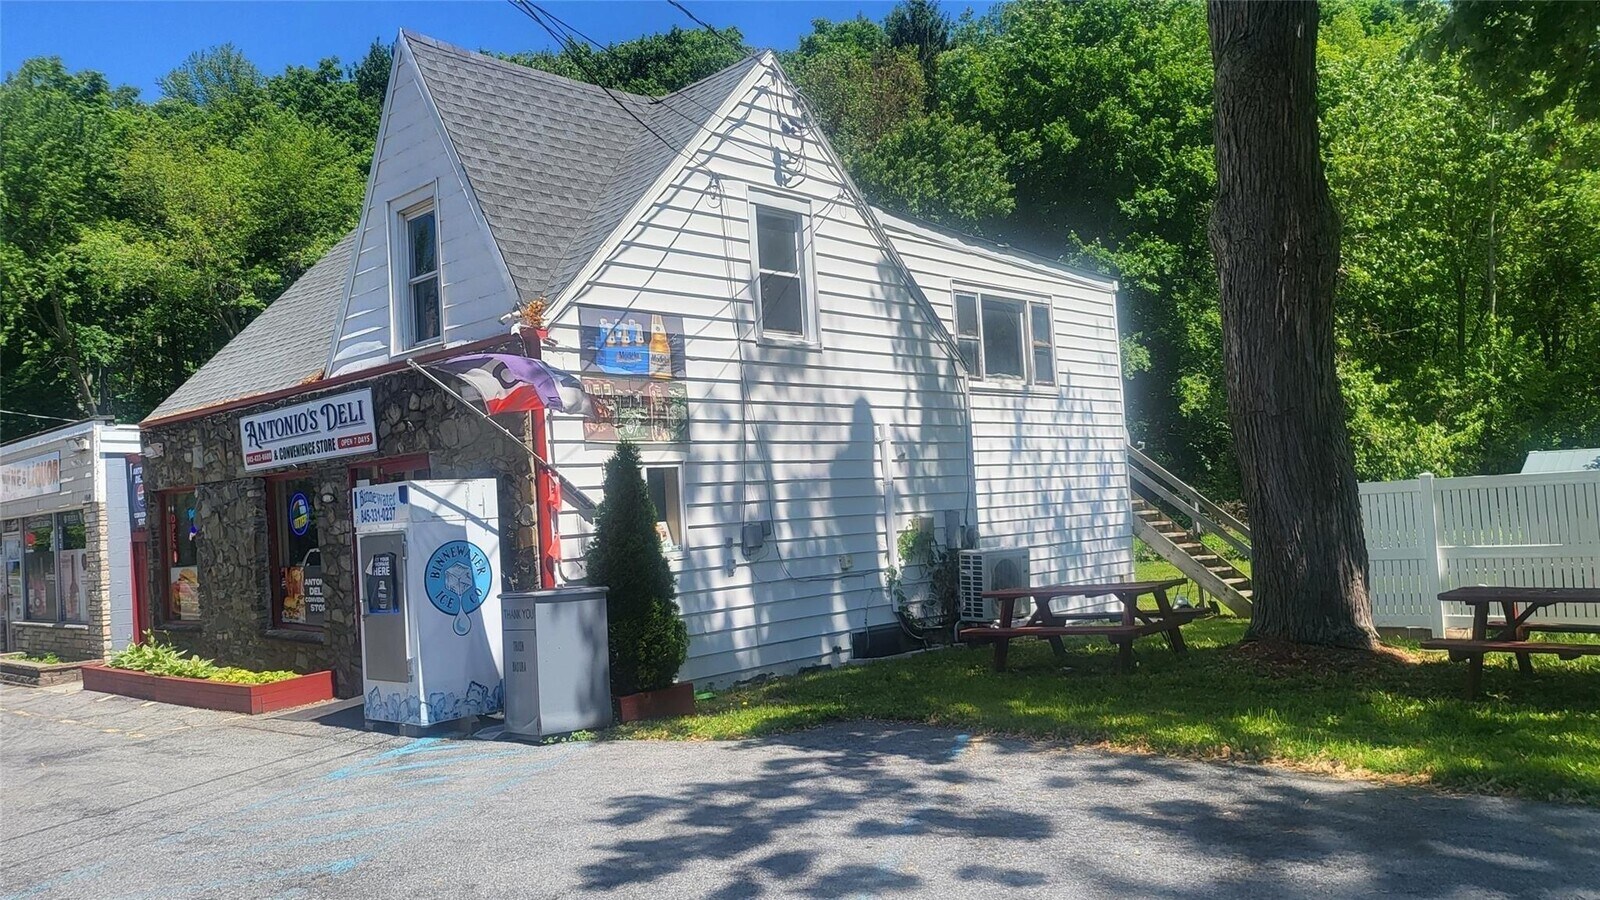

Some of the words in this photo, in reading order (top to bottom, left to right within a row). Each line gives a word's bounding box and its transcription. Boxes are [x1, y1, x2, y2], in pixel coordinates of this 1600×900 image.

[244, 409, 319, 449] ANTONIO'S
[320, 400, 365, 431] DELI
[273, 450, 279, 460] &
[279, 441, 316, 460] CONVENIENCE
[315, 438, 337, 454] STORE
[340, 438, 353, 447] OPEN
[357, 434, 370, 444] DAYS
[430, 544, 486, 580] BINNEWATER
[373, 566, 391, 576] HERE
[309, 587, 323, 596] DEL
[435, 590, 454, 609] ICE
[469, 588, 483, 604] CO
[503, 608, 521, 620] THANK
[522, 608, 535, 620] YOU
